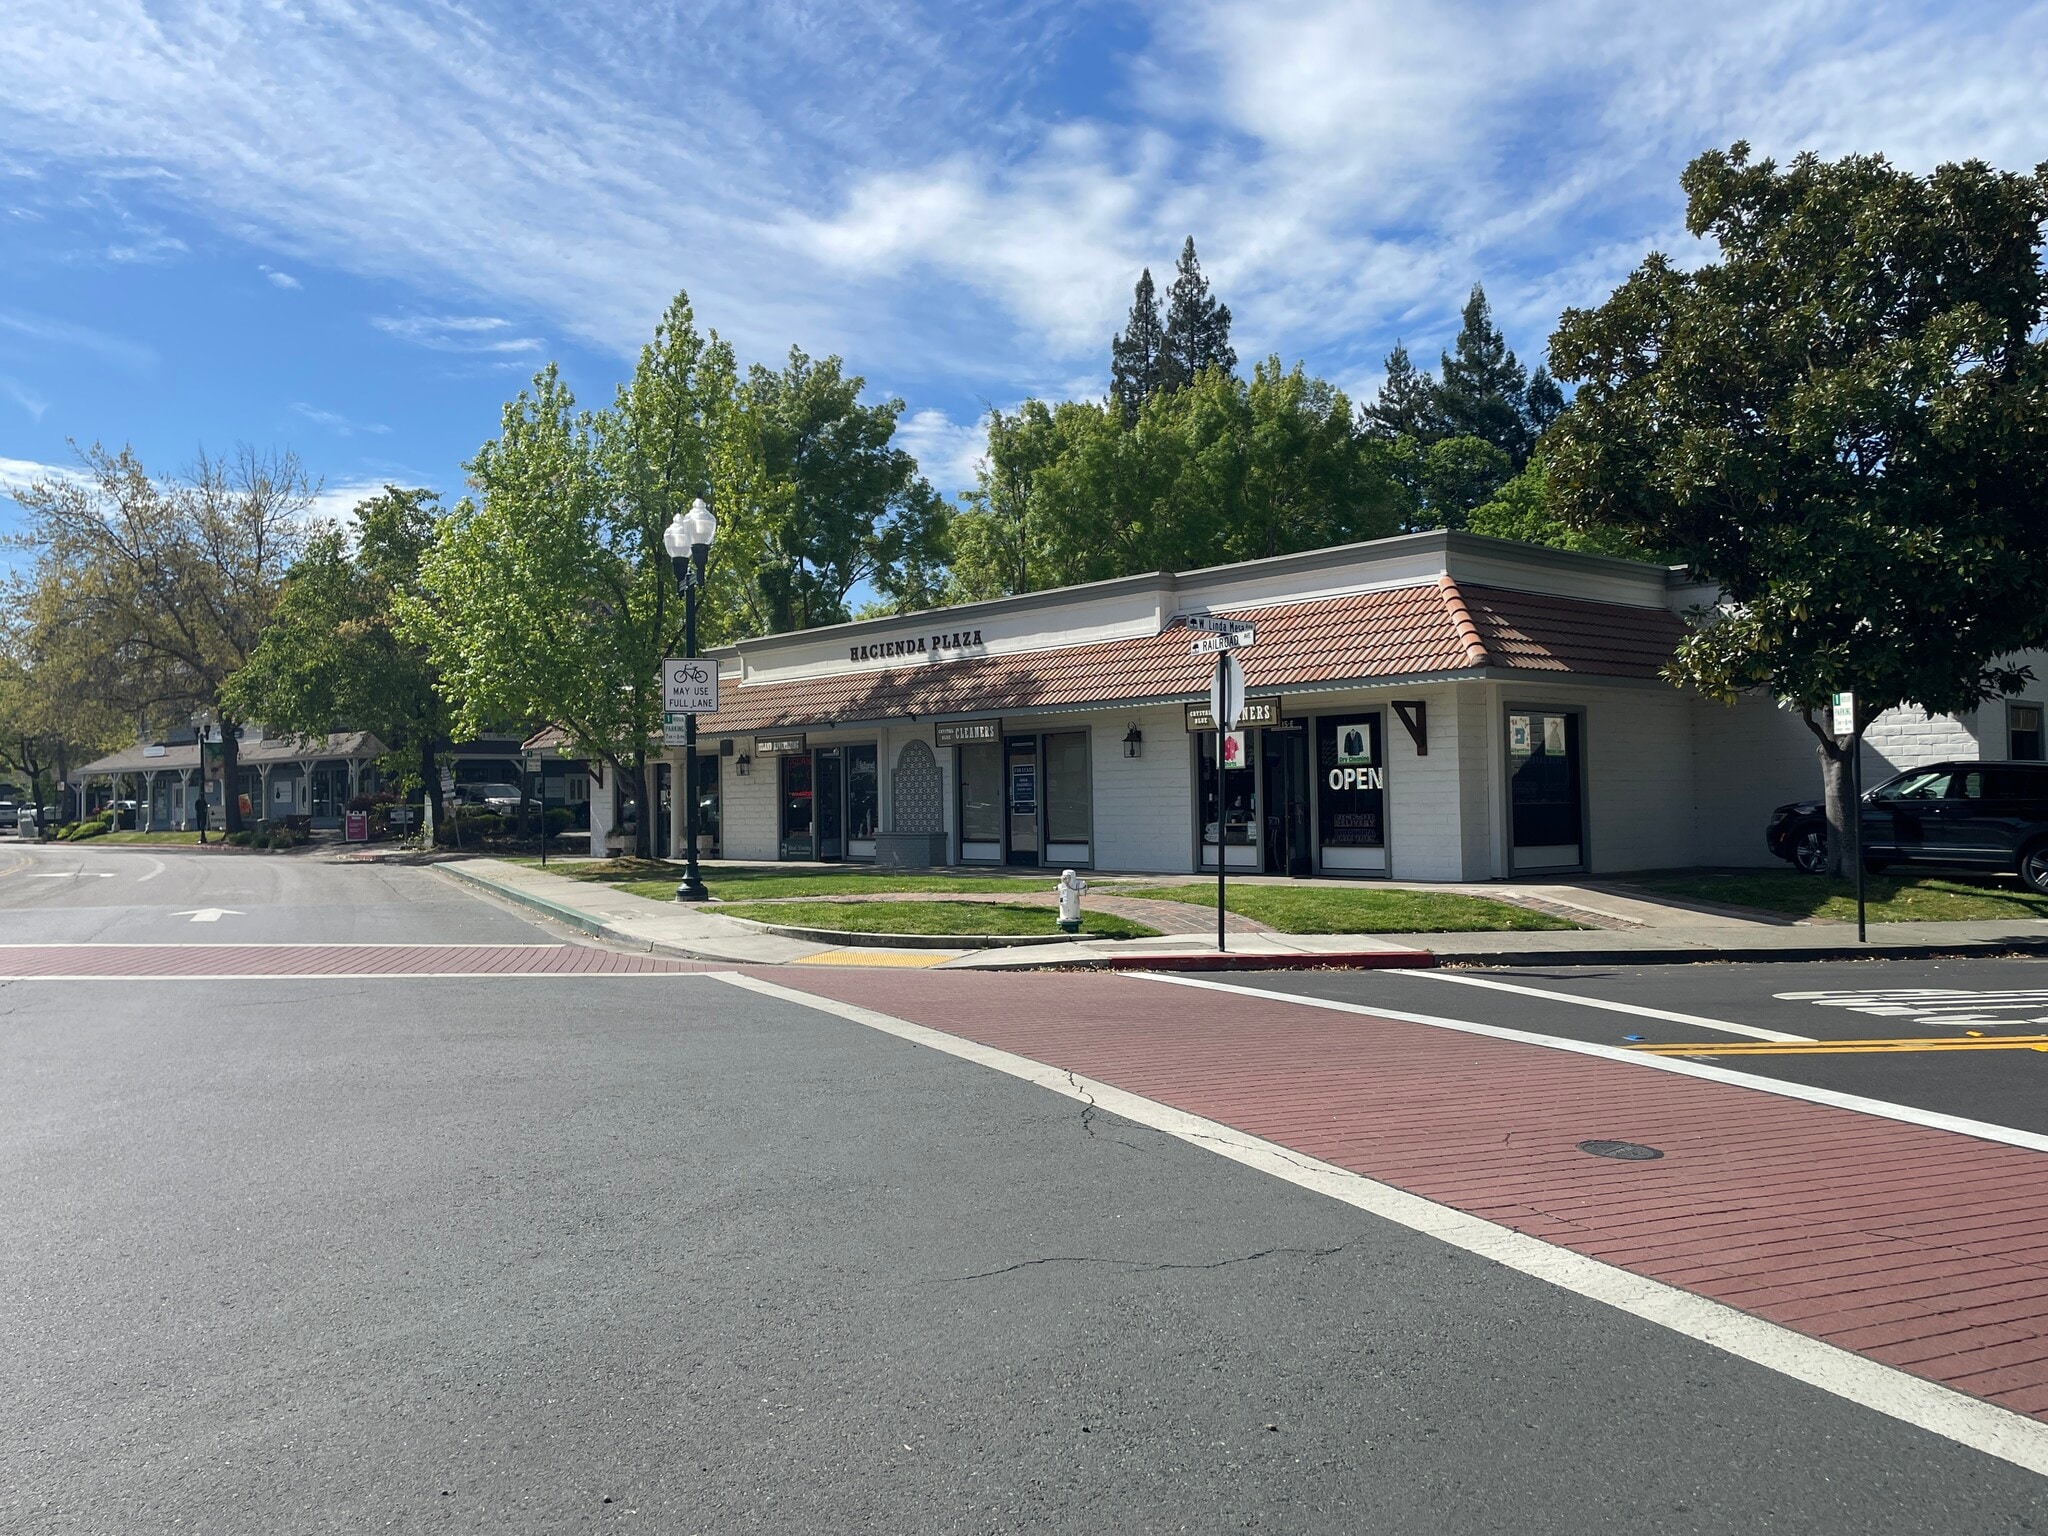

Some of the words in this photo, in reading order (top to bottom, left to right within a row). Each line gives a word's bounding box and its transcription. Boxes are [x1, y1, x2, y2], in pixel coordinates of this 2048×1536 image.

[1209, 619, 1226, 632] Linda
[1230, 622, 1244, 633] Mesa
[850, 638, 926, 660] HACIENDA
[932, 630, 983, 650] PLAZA
[1203, 634, 1239, 652] RAILROAD
[673, 687, 690, 695] MAY
[694, 687, 709, 695] USE
[669, 699, 688, 707] FULL
[692, 699, 713, 707] LANE
[955, 726, 995, 740] CLEANERS
[1329, 767, 1383, 790] OPEN
